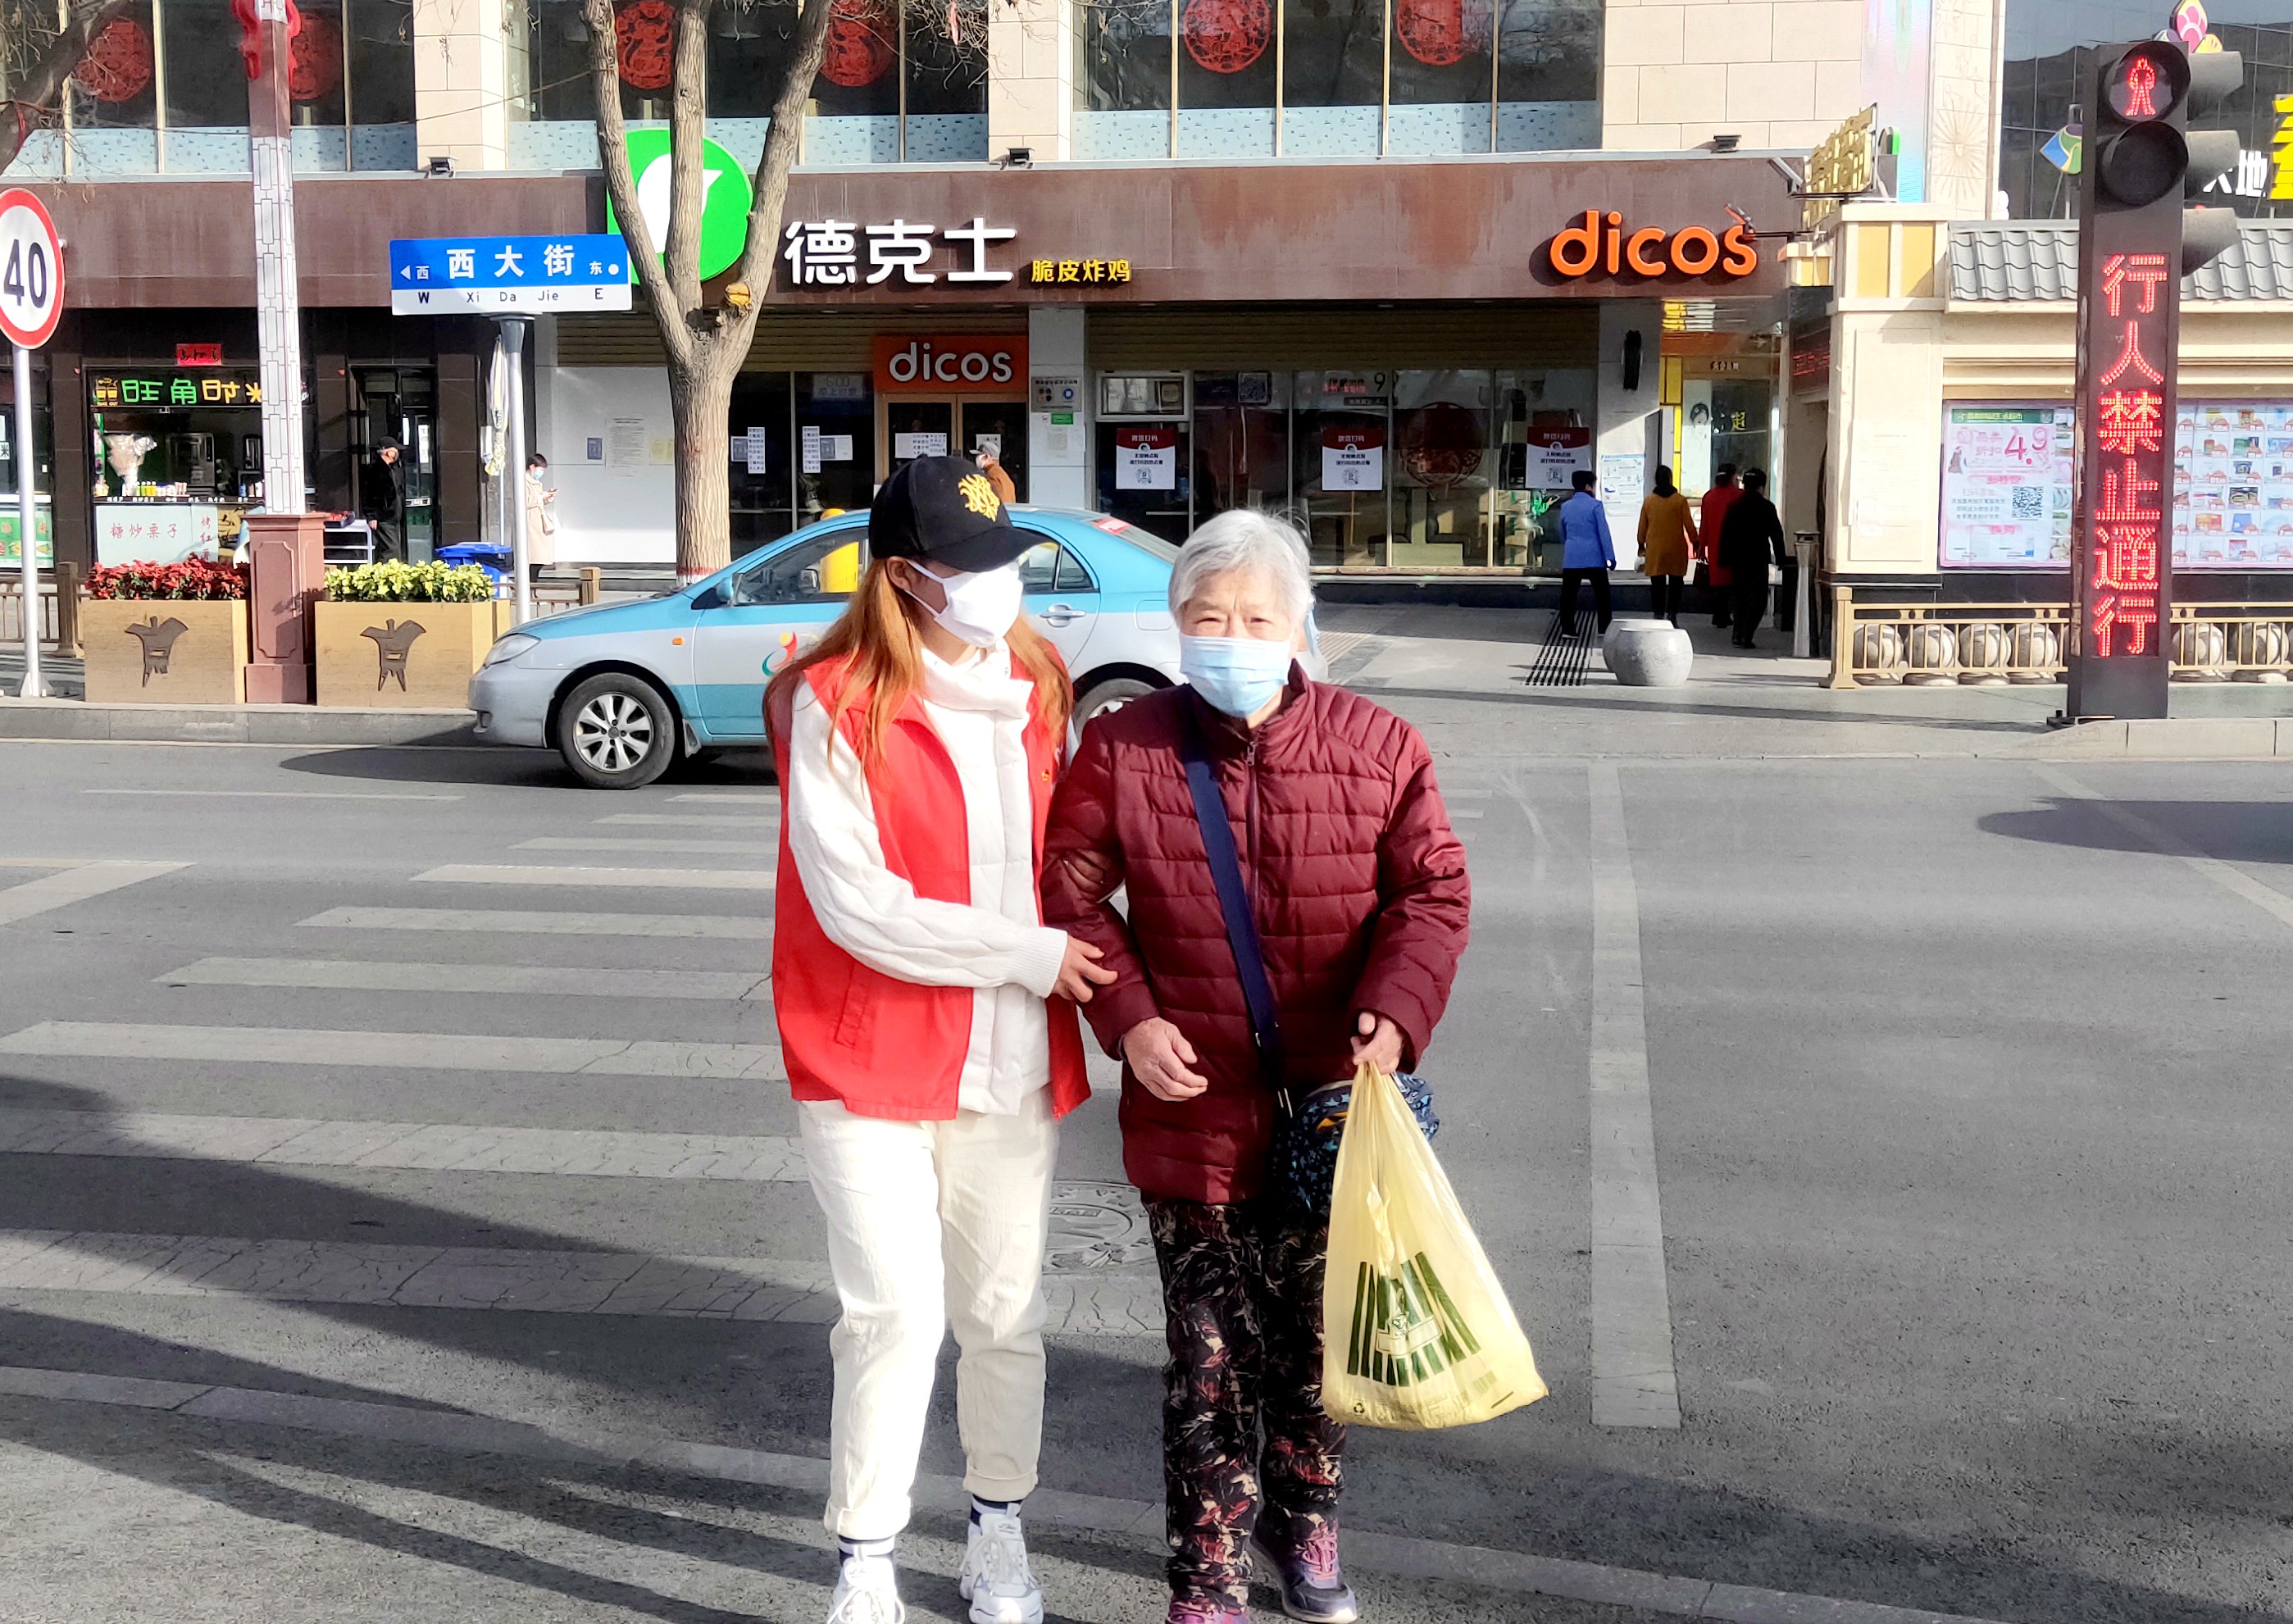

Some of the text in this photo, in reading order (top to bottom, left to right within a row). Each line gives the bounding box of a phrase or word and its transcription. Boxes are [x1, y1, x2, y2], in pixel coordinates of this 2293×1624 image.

[416, 243, 603, 280] 西 西大街 东
[785, 217, 1017, 284] 德克士
[1549, 209, 1758, 277] dicos
[4, 239, 47, 309] 40
[1031, 259, 1131, 284] 脆皮炸鸡
[418, 289, 603, 304] W Xi Da Jie E
[889, 342, 1012, 382] dicos
[2093, 254, 2168, 657] 行人禁止通行
[110, 523, 178, 539] 糖炒栗子
